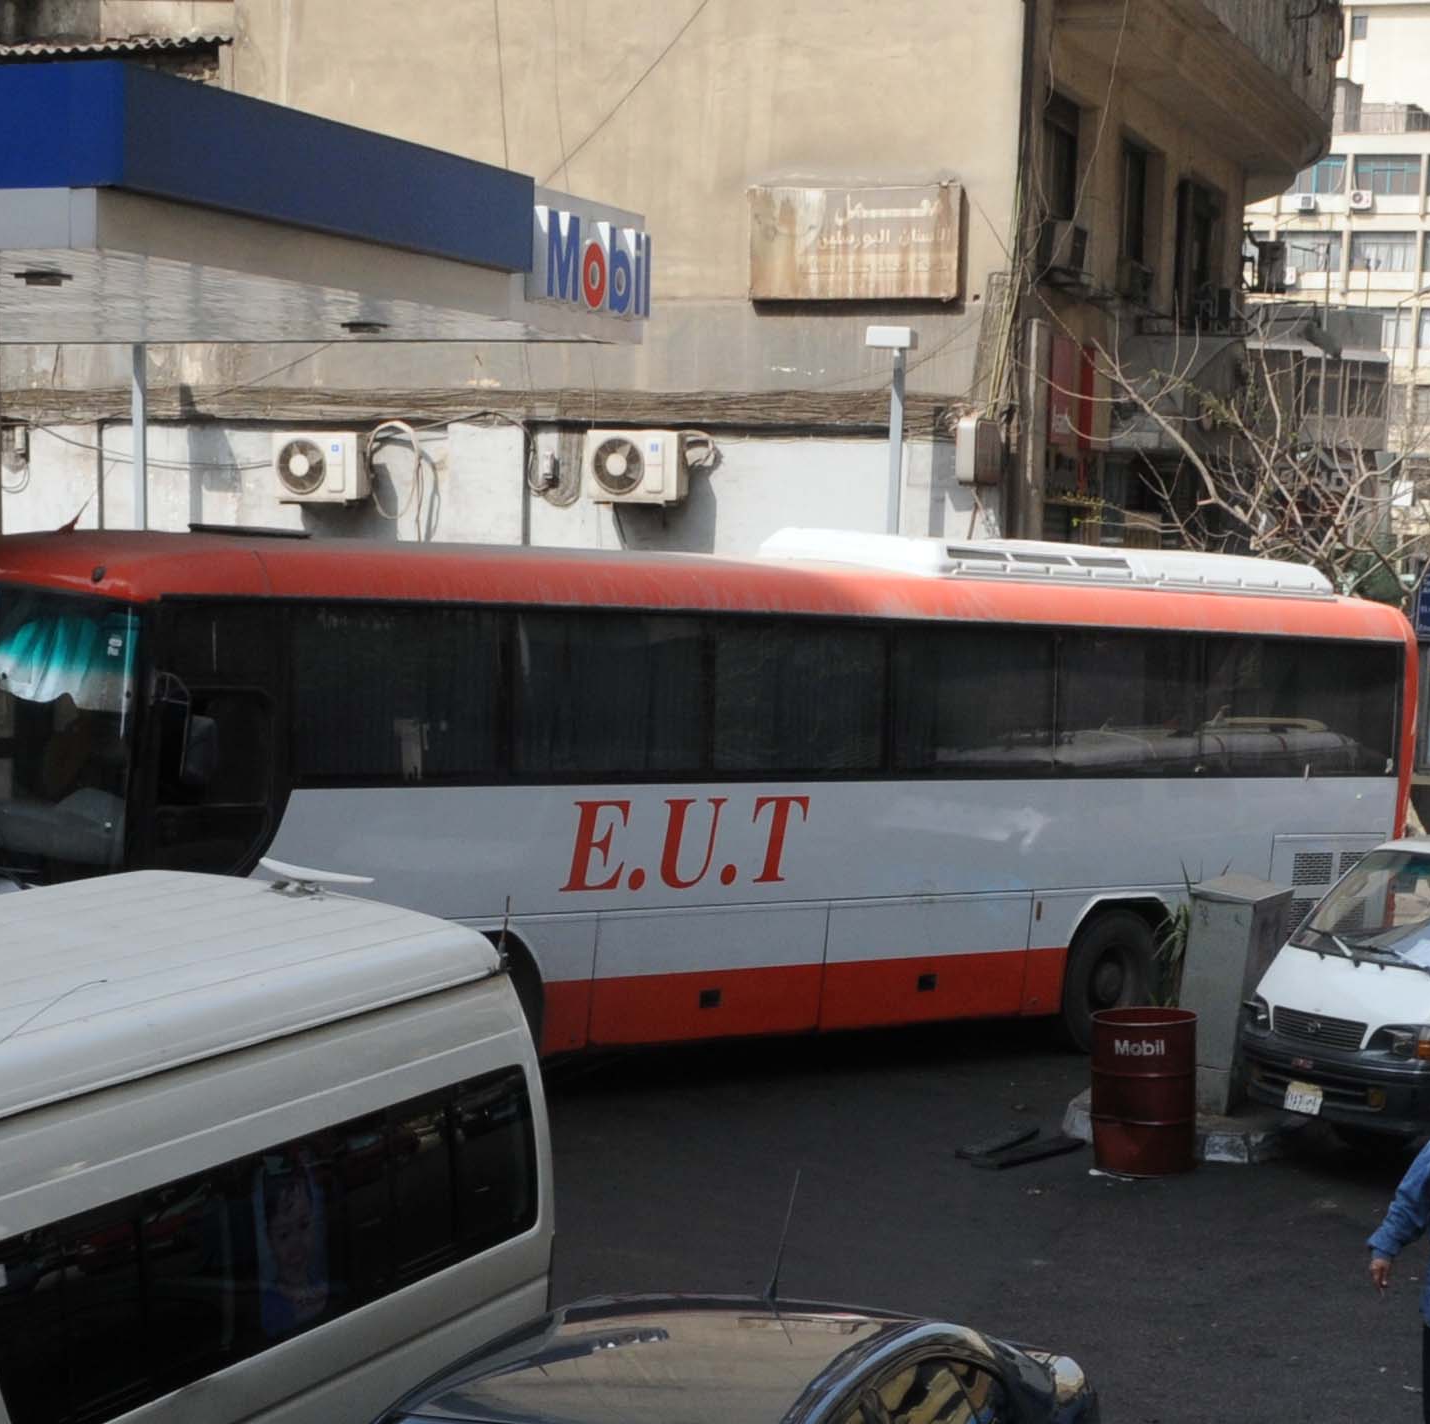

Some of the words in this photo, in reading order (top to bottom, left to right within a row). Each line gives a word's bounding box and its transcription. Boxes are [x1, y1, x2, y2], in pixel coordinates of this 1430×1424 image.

[547, 209, 651, 318] Mobil
[559, 795, 811, 892] E.U.T
[1114, 1039, 1165, 1056] Mobil
